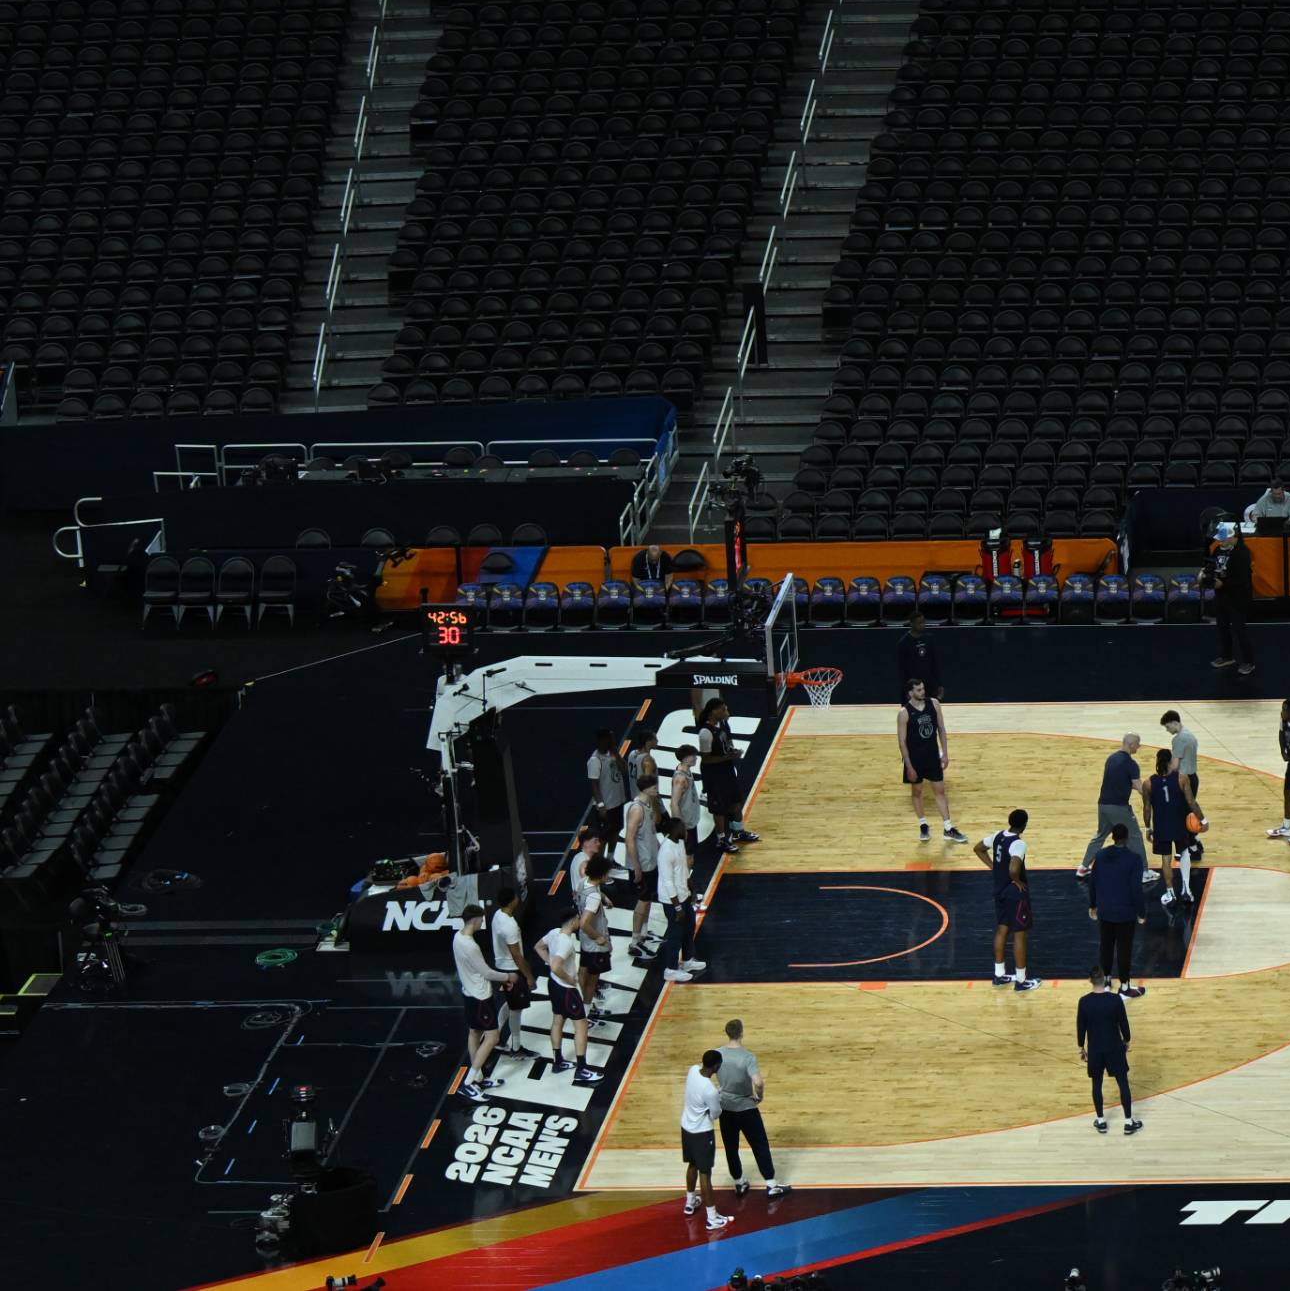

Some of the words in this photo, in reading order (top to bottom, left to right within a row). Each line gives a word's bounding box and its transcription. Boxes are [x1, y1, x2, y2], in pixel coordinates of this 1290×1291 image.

[428, 610, 467, 624] 42:56
[438, 626, 460, 644] 30
[692, 674, 738, 686] SPALDING
[1162, 785, 1170, 804] 1
[995, 844, 1003, 862] 5
[382, 900, 487, 932] NCA
[445, 1105, 508, 1184] 2026
[480, 1111, 544, 1186] NCAA
[517, 1114, 579, 1189] MEN'S
